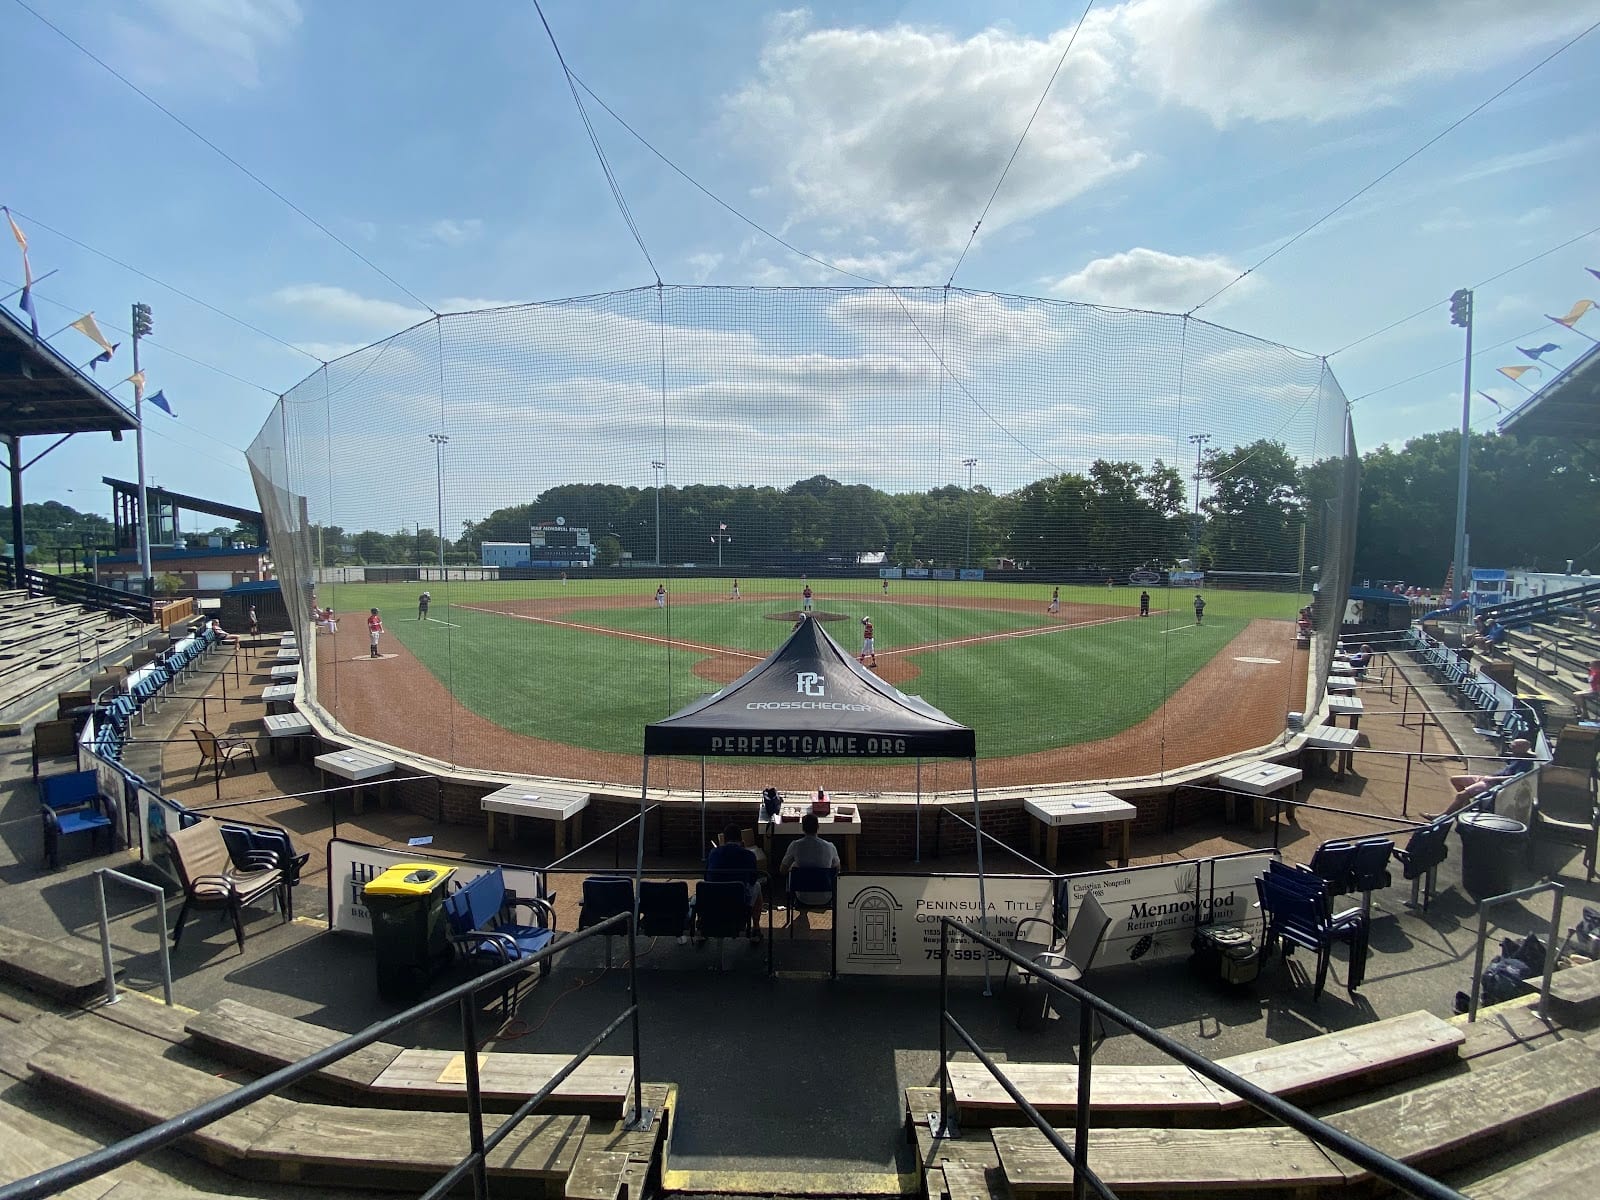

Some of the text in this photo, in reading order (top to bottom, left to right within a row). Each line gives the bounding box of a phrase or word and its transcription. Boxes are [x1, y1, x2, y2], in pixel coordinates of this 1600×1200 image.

[796, 672, 825, 696] PG
[746, 701, 873, 712] CROSSCHECKER
[711, 735, 906, 754] PERFECTGAME.ORG
[1073, 877, 1131, 892] Christian Nonprofit
[916, 899, 1041, 911] PENINSULA TITLE
[1129, 892, 1234, 920] Mennowood
[1127, 917, 1178, 931] Retirement
